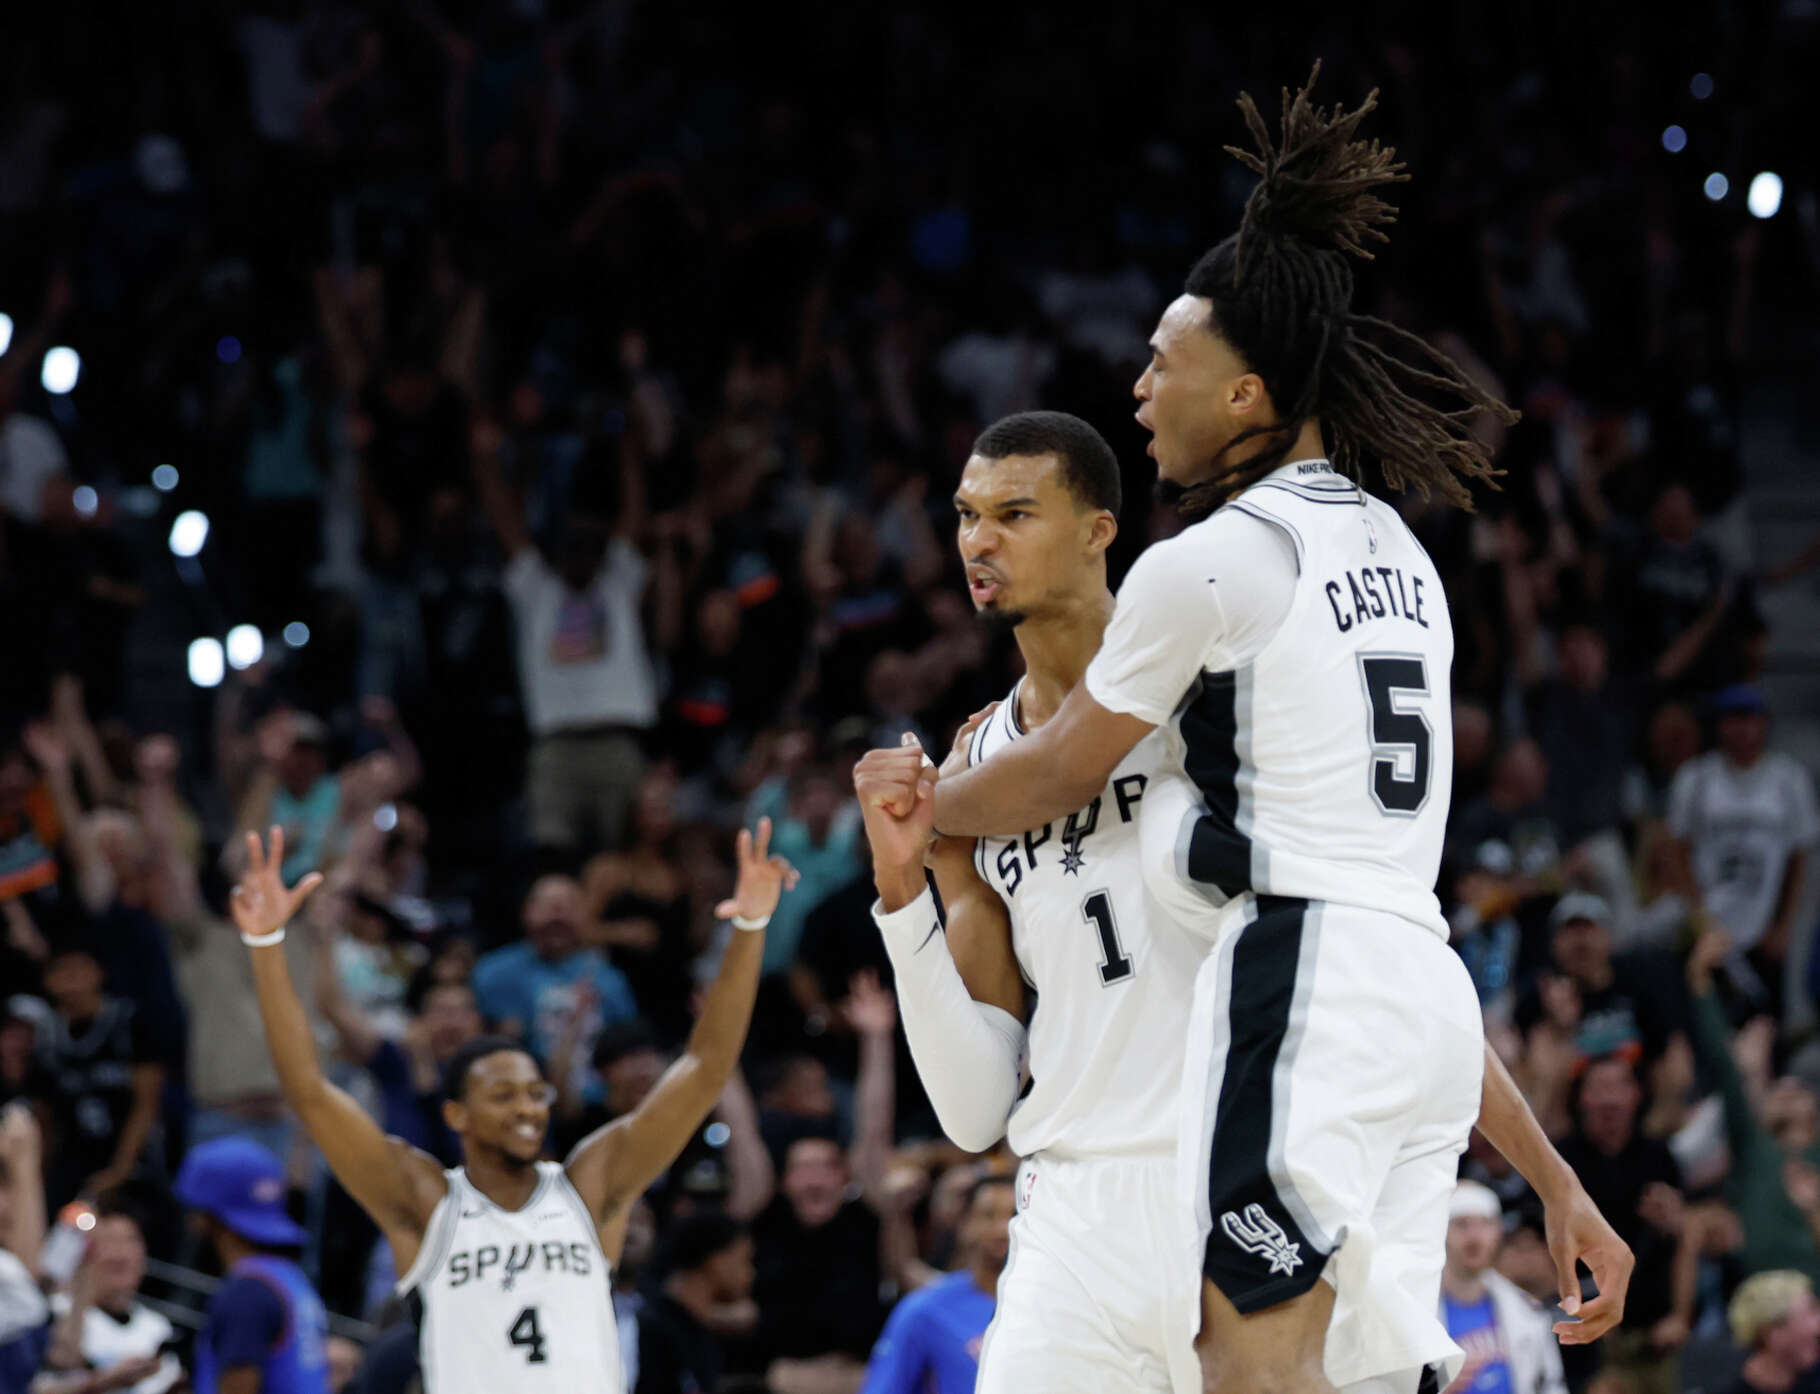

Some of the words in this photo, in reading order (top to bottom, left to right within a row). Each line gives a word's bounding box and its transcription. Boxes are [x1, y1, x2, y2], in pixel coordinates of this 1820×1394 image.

[1297, 464, 1319, 475] NIKE
[1325, 566, 1429, 632] CASTLE
[1355, 651, 1434, 819] 5
[996, 773, 1149, 898] SPUR
[1080, 887, 1136, 989] 1
[449, 1241, 591, 1291] SPURS
[508, 1306, 548, 1364] 4
